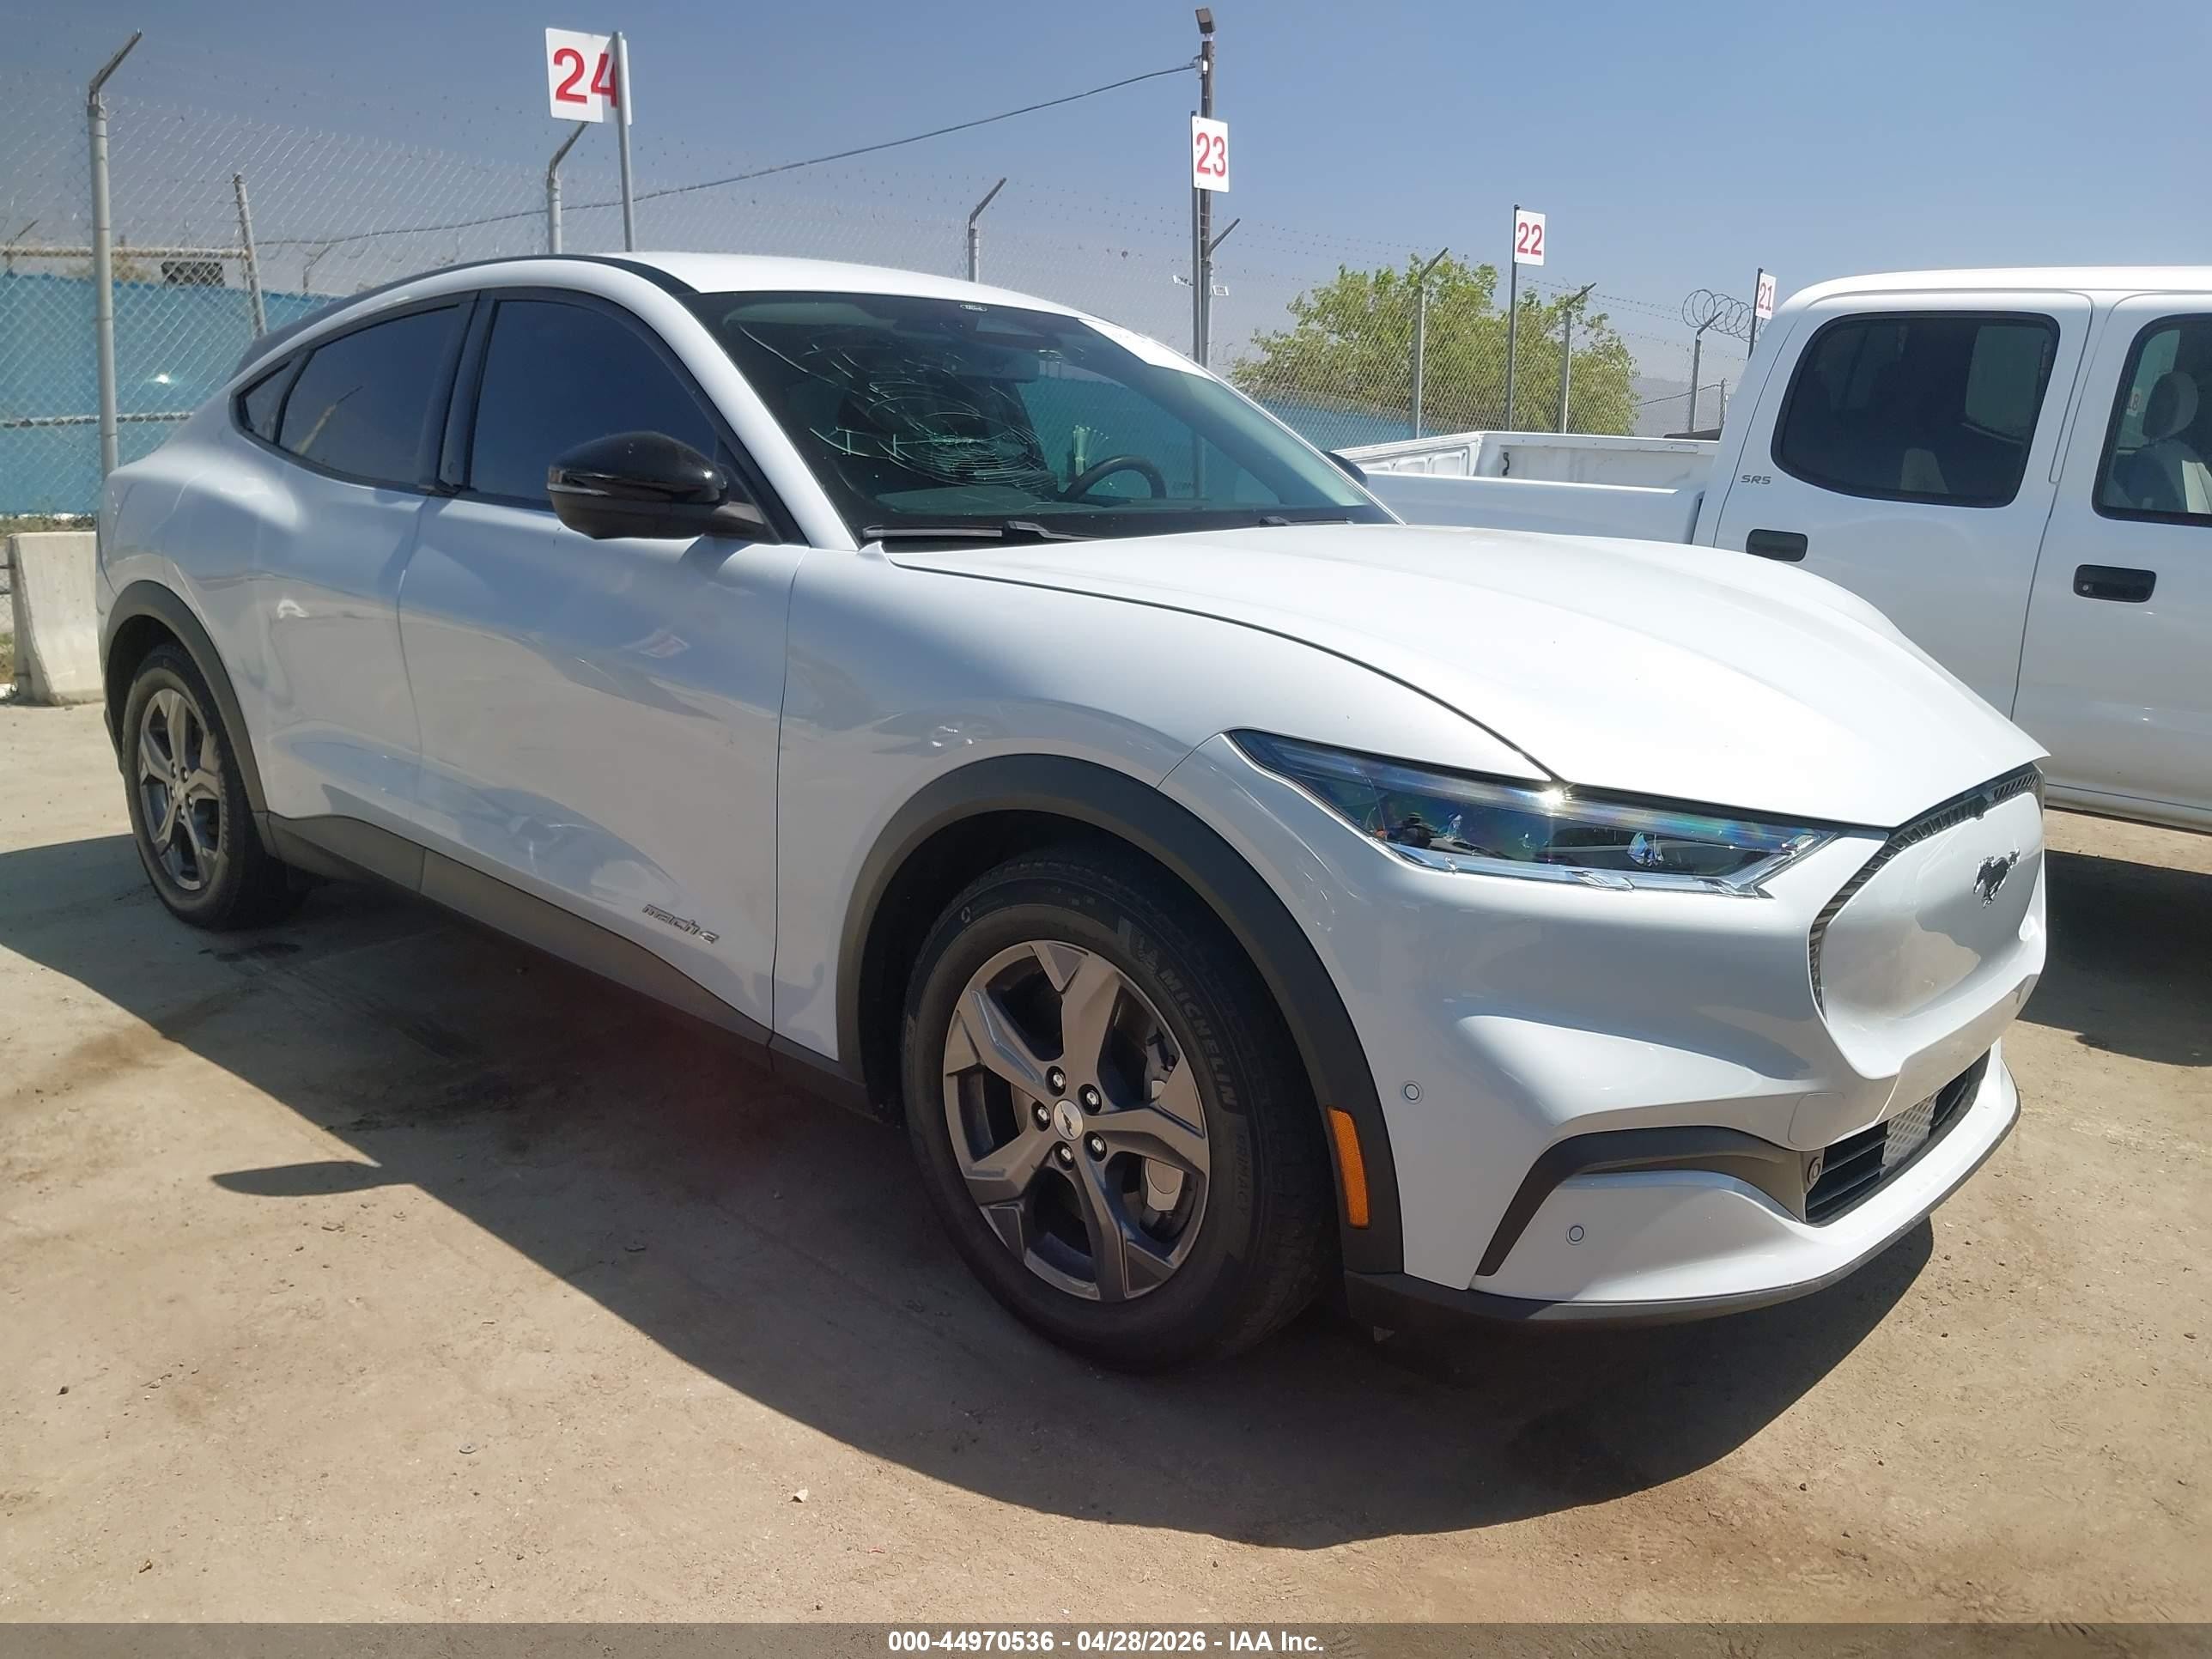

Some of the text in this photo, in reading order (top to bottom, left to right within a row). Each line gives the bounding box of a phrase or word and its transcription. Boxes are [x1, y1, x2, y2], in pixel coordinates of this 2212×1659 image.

[554, 48, 617, 108] 24
[1196, 132, 1225, 177] 23
[1517, 222, 1542, 256] 22
[1758, 283, 1772, 311] 21
[1741, 475, 1771, 484] SR5
[1159, 969, 1237, 1106] MICHELIN
